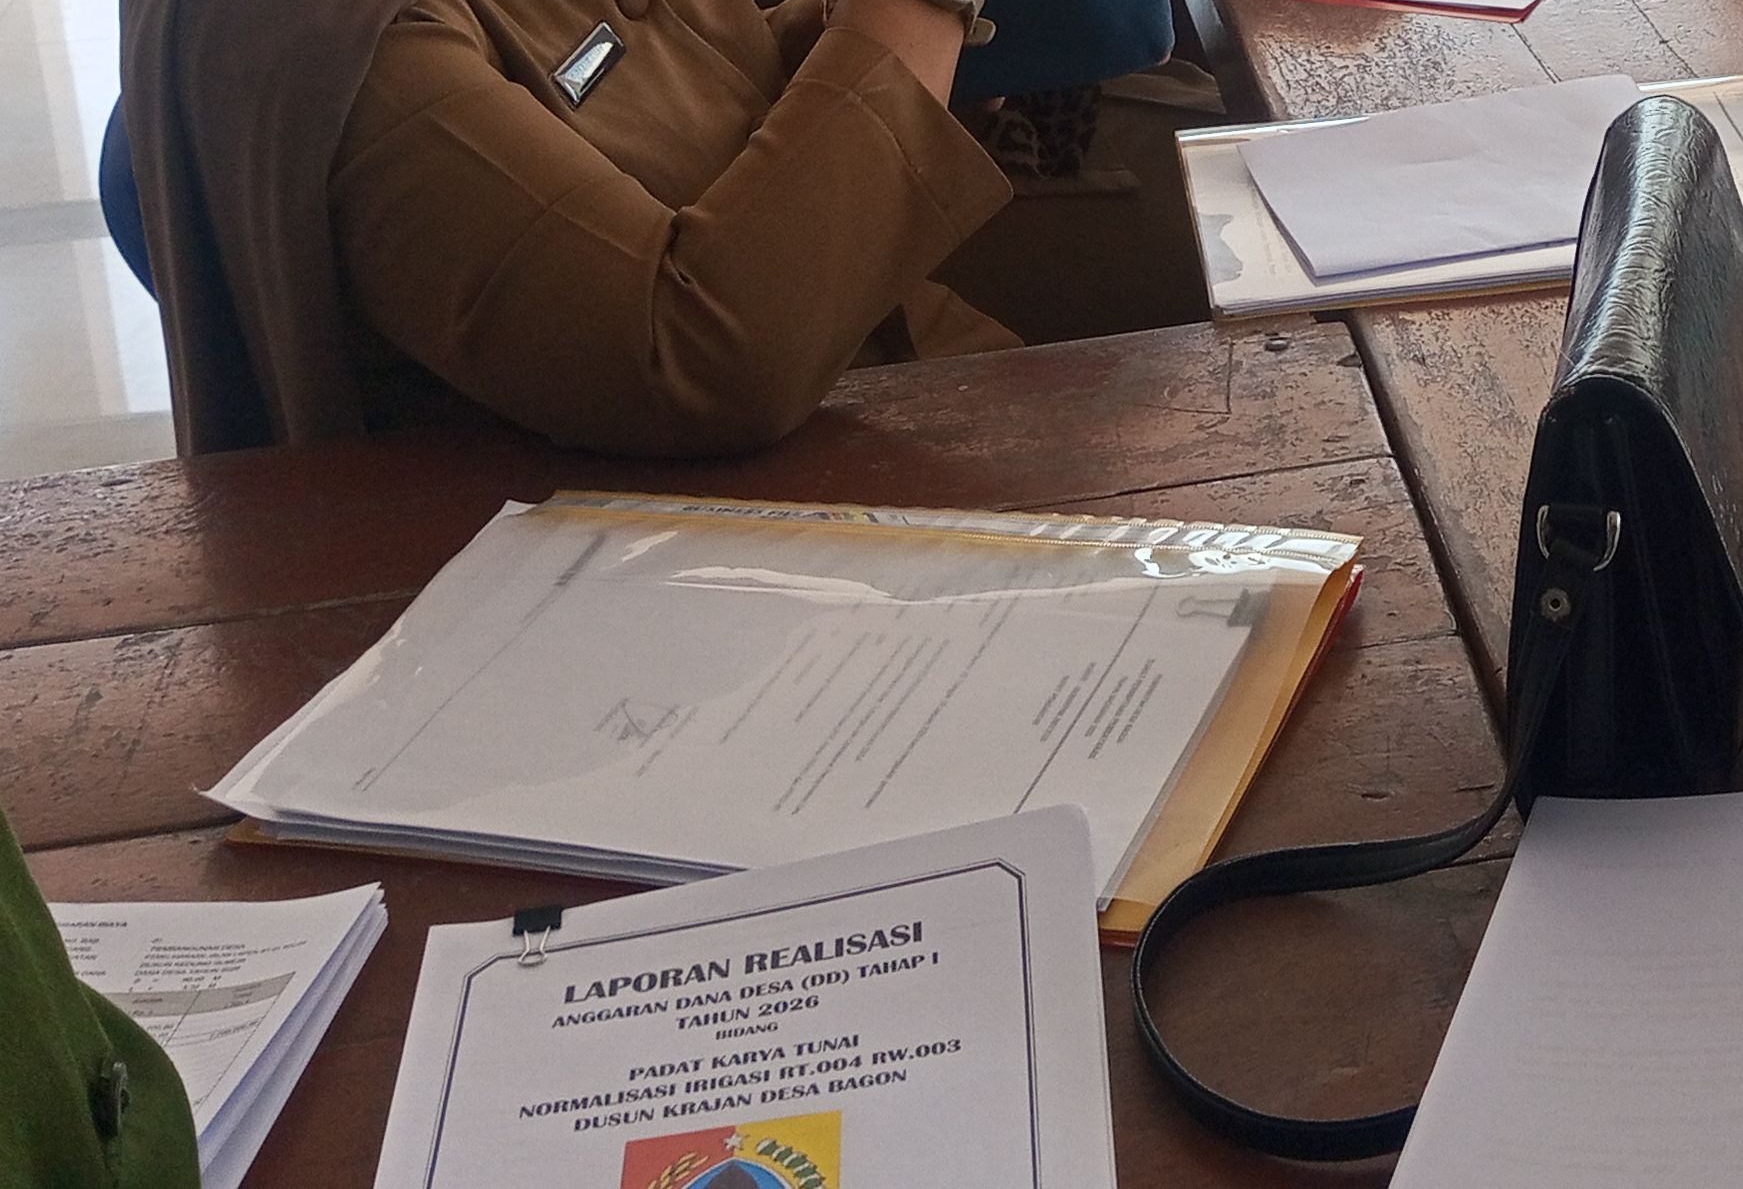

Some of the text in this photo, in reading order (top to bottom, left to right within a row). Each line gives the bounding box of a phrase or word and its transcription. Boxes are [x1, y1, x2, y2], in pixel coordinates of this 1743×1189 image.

[551, 952, 939, 1029] ANGGARAN DANA DESA (DD) TAHAP I
[564, 921, 922, 1003] LAPORAN REALISASI
[675, 995, 819, 1030] TAHUN 2026
[715, 1022, 778, 1040] BIDANG
[519, 1039, 962, 1119] NORMALISASI IRIGASI RT.004 RW.003
[629, 1034, 859, 1081] PADAT KARYA TUNAI
[573, 1069, 907, 1132] DUSUN KRAJAN DESA BAGON
